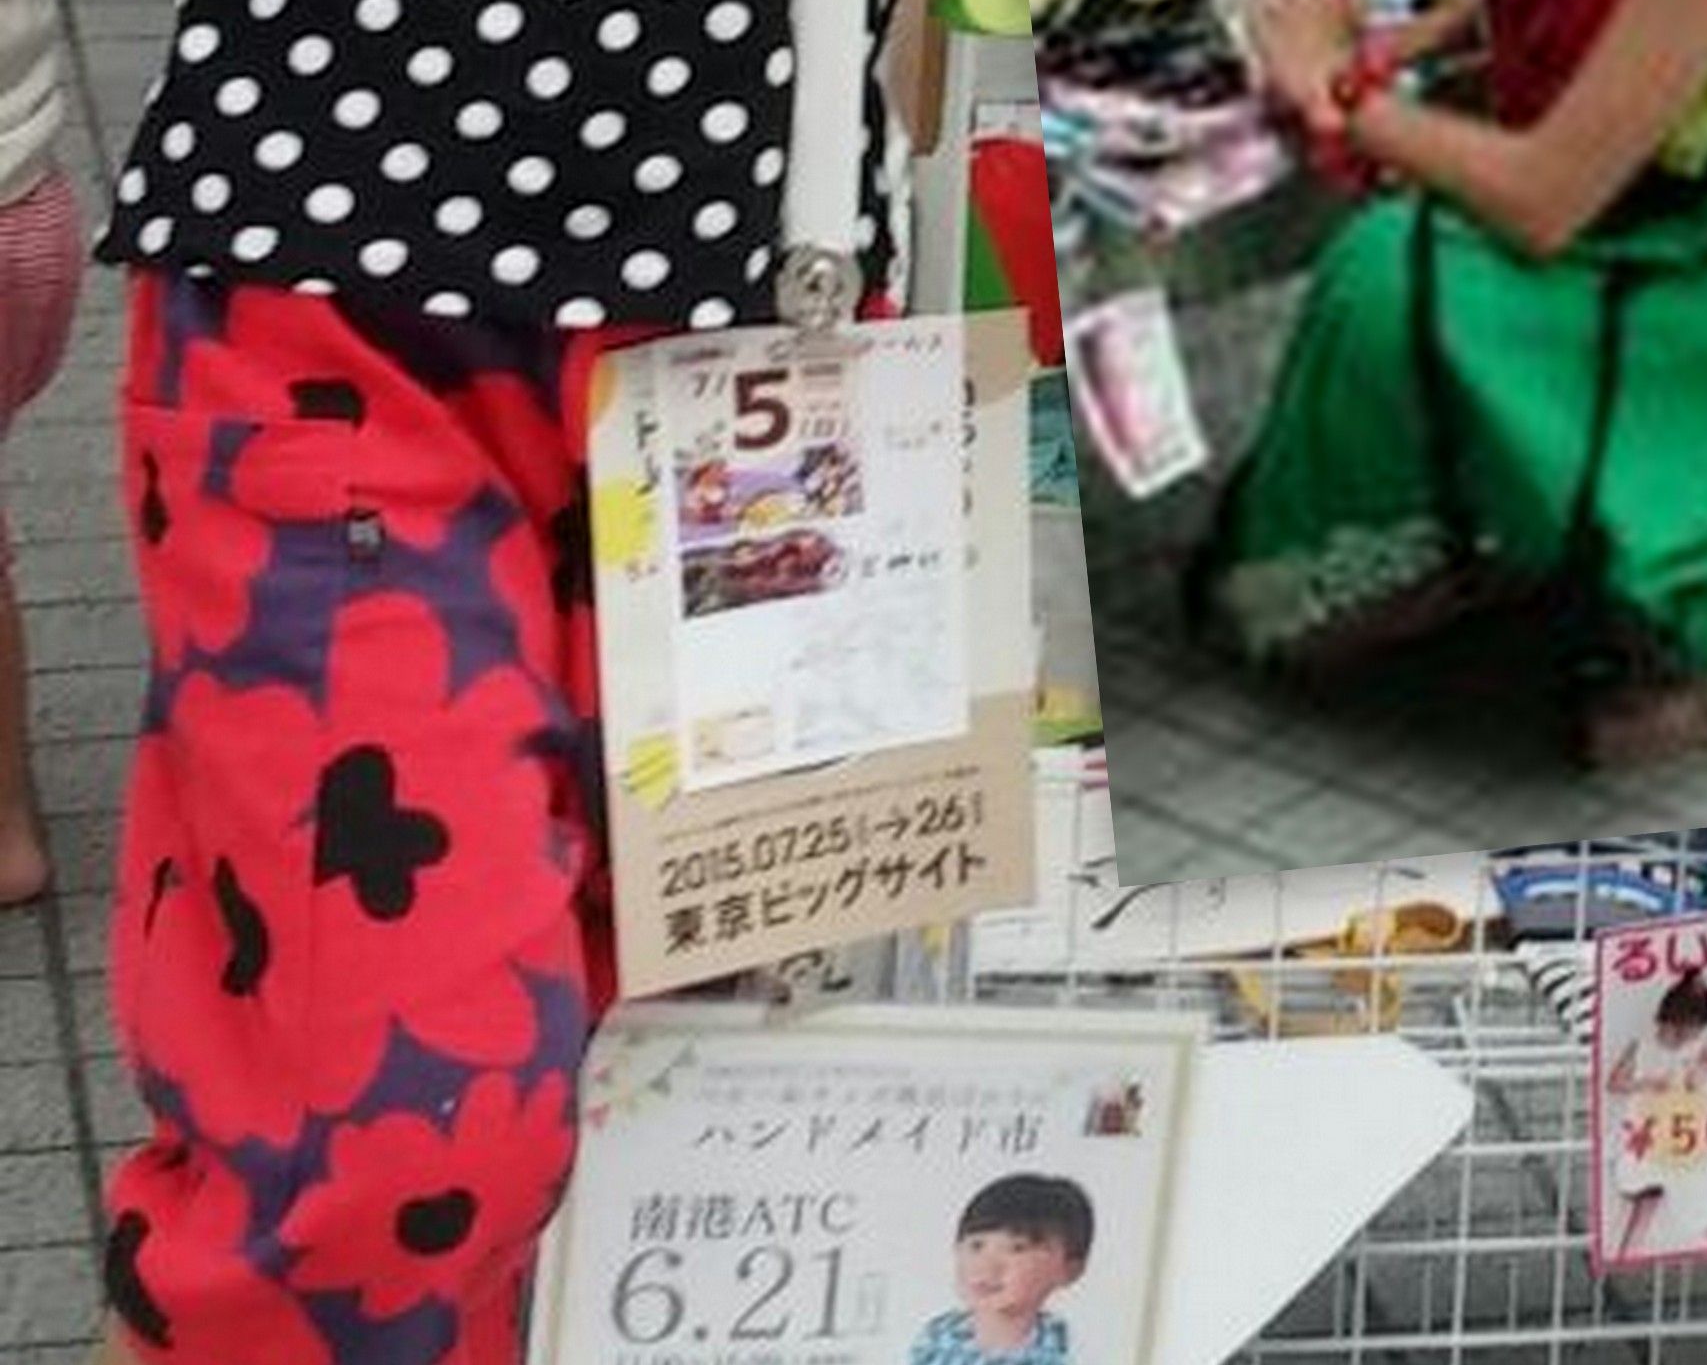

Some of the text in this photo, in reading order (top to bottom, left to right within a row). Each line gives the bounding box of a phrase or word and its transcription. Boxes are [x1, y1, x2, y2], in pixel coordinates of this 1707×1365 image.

[734, 369, 790, 451] 5
[665, 841, 988, 956] 東京ビッグサイト
[695, 1114, 1044, 1153] ハンドメイド市
[630, 1192, 857, 1242] 南港ATC
[611, 1245, 842, 1344] 6.21
